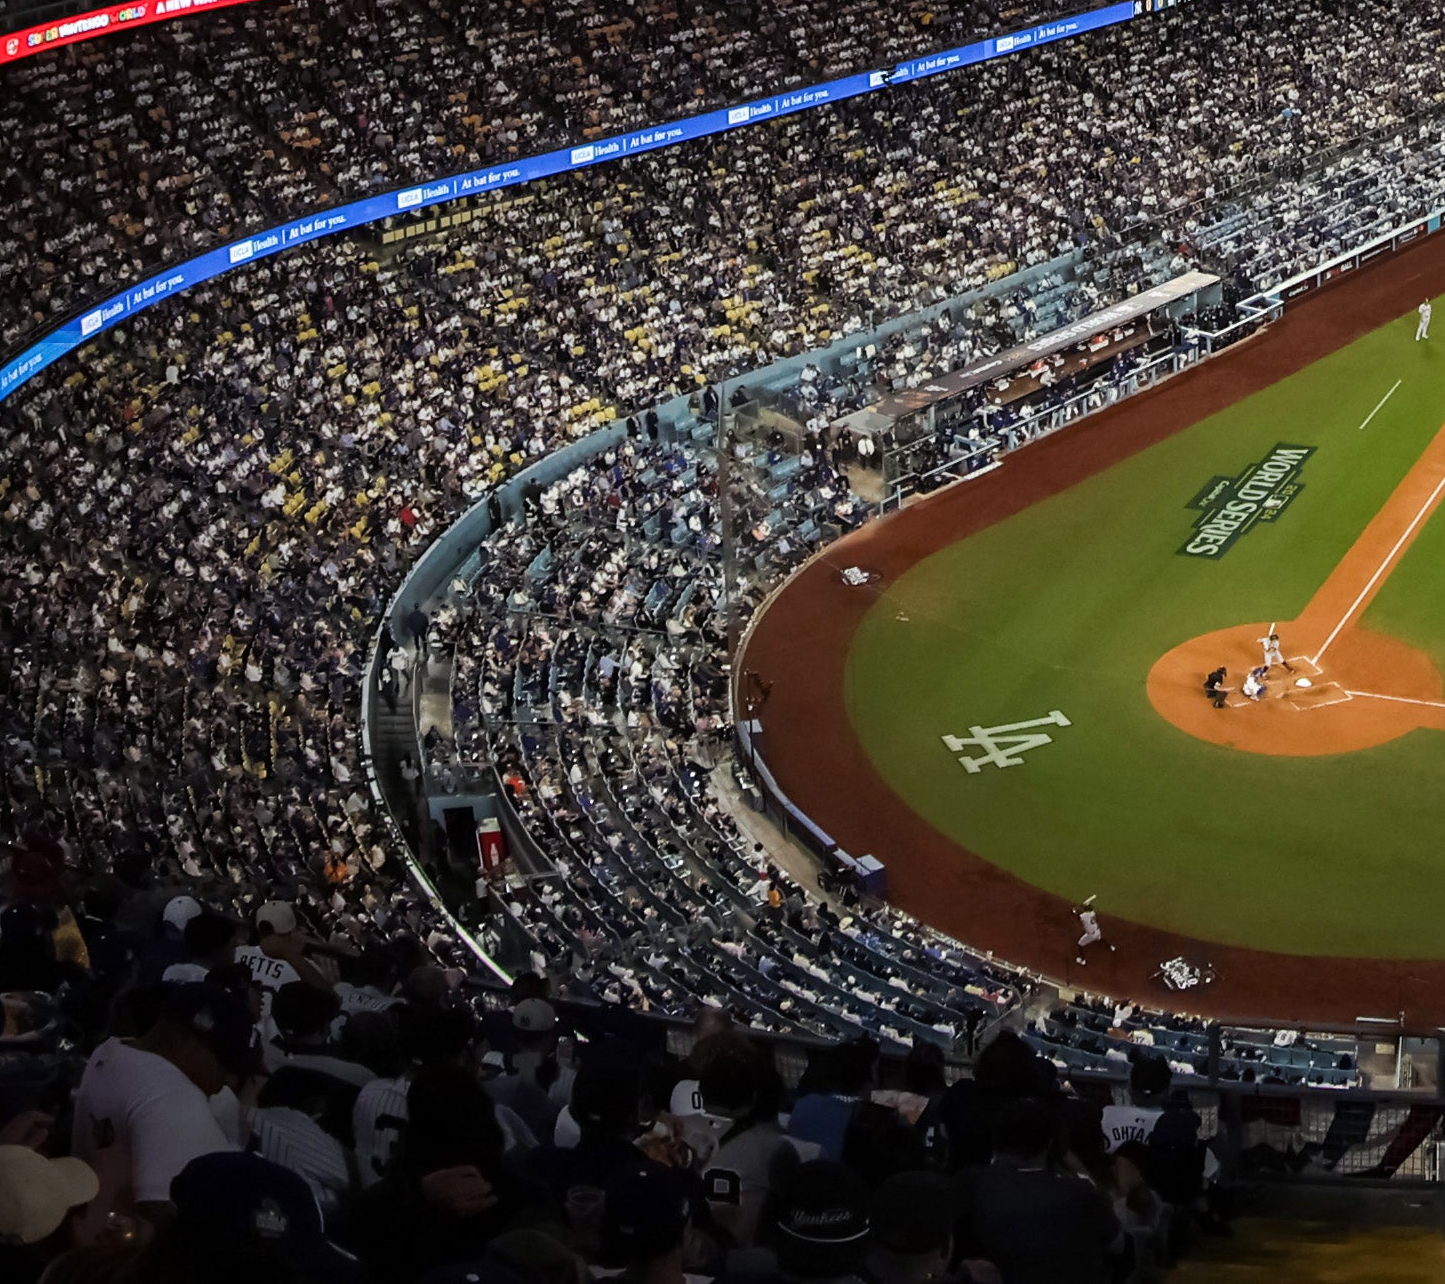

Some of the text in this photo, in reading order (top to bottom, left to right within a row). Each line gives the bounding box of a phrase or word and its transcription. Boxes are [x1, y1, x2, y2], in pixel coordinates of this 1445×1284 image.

[155, 2, 166, 14] A
[28, 6, 146, 47] SUPER NINTENDO WORLD
[750, 102, 771, 117] Health
[595, 141, 619, 157] Health
[423, 184, 449, 200] Health
[462, 178, 472, 190] At
[474, 174, 487, 188] bat
[488, 171, 502, 185] for
[502, 168, 520, 184] you.
[253, 235, 278, 252] Health
[289, 227, 299, 240] At
[300, 224, 313, 238] bat
[314, 219, 327, 232] for
[328, 214, 346, 229] you.
[102, 302, 124, 321] Health
[1186, 447, 1309, 556] WORLD SERIES
[941, 710, 1072, 774] LA
